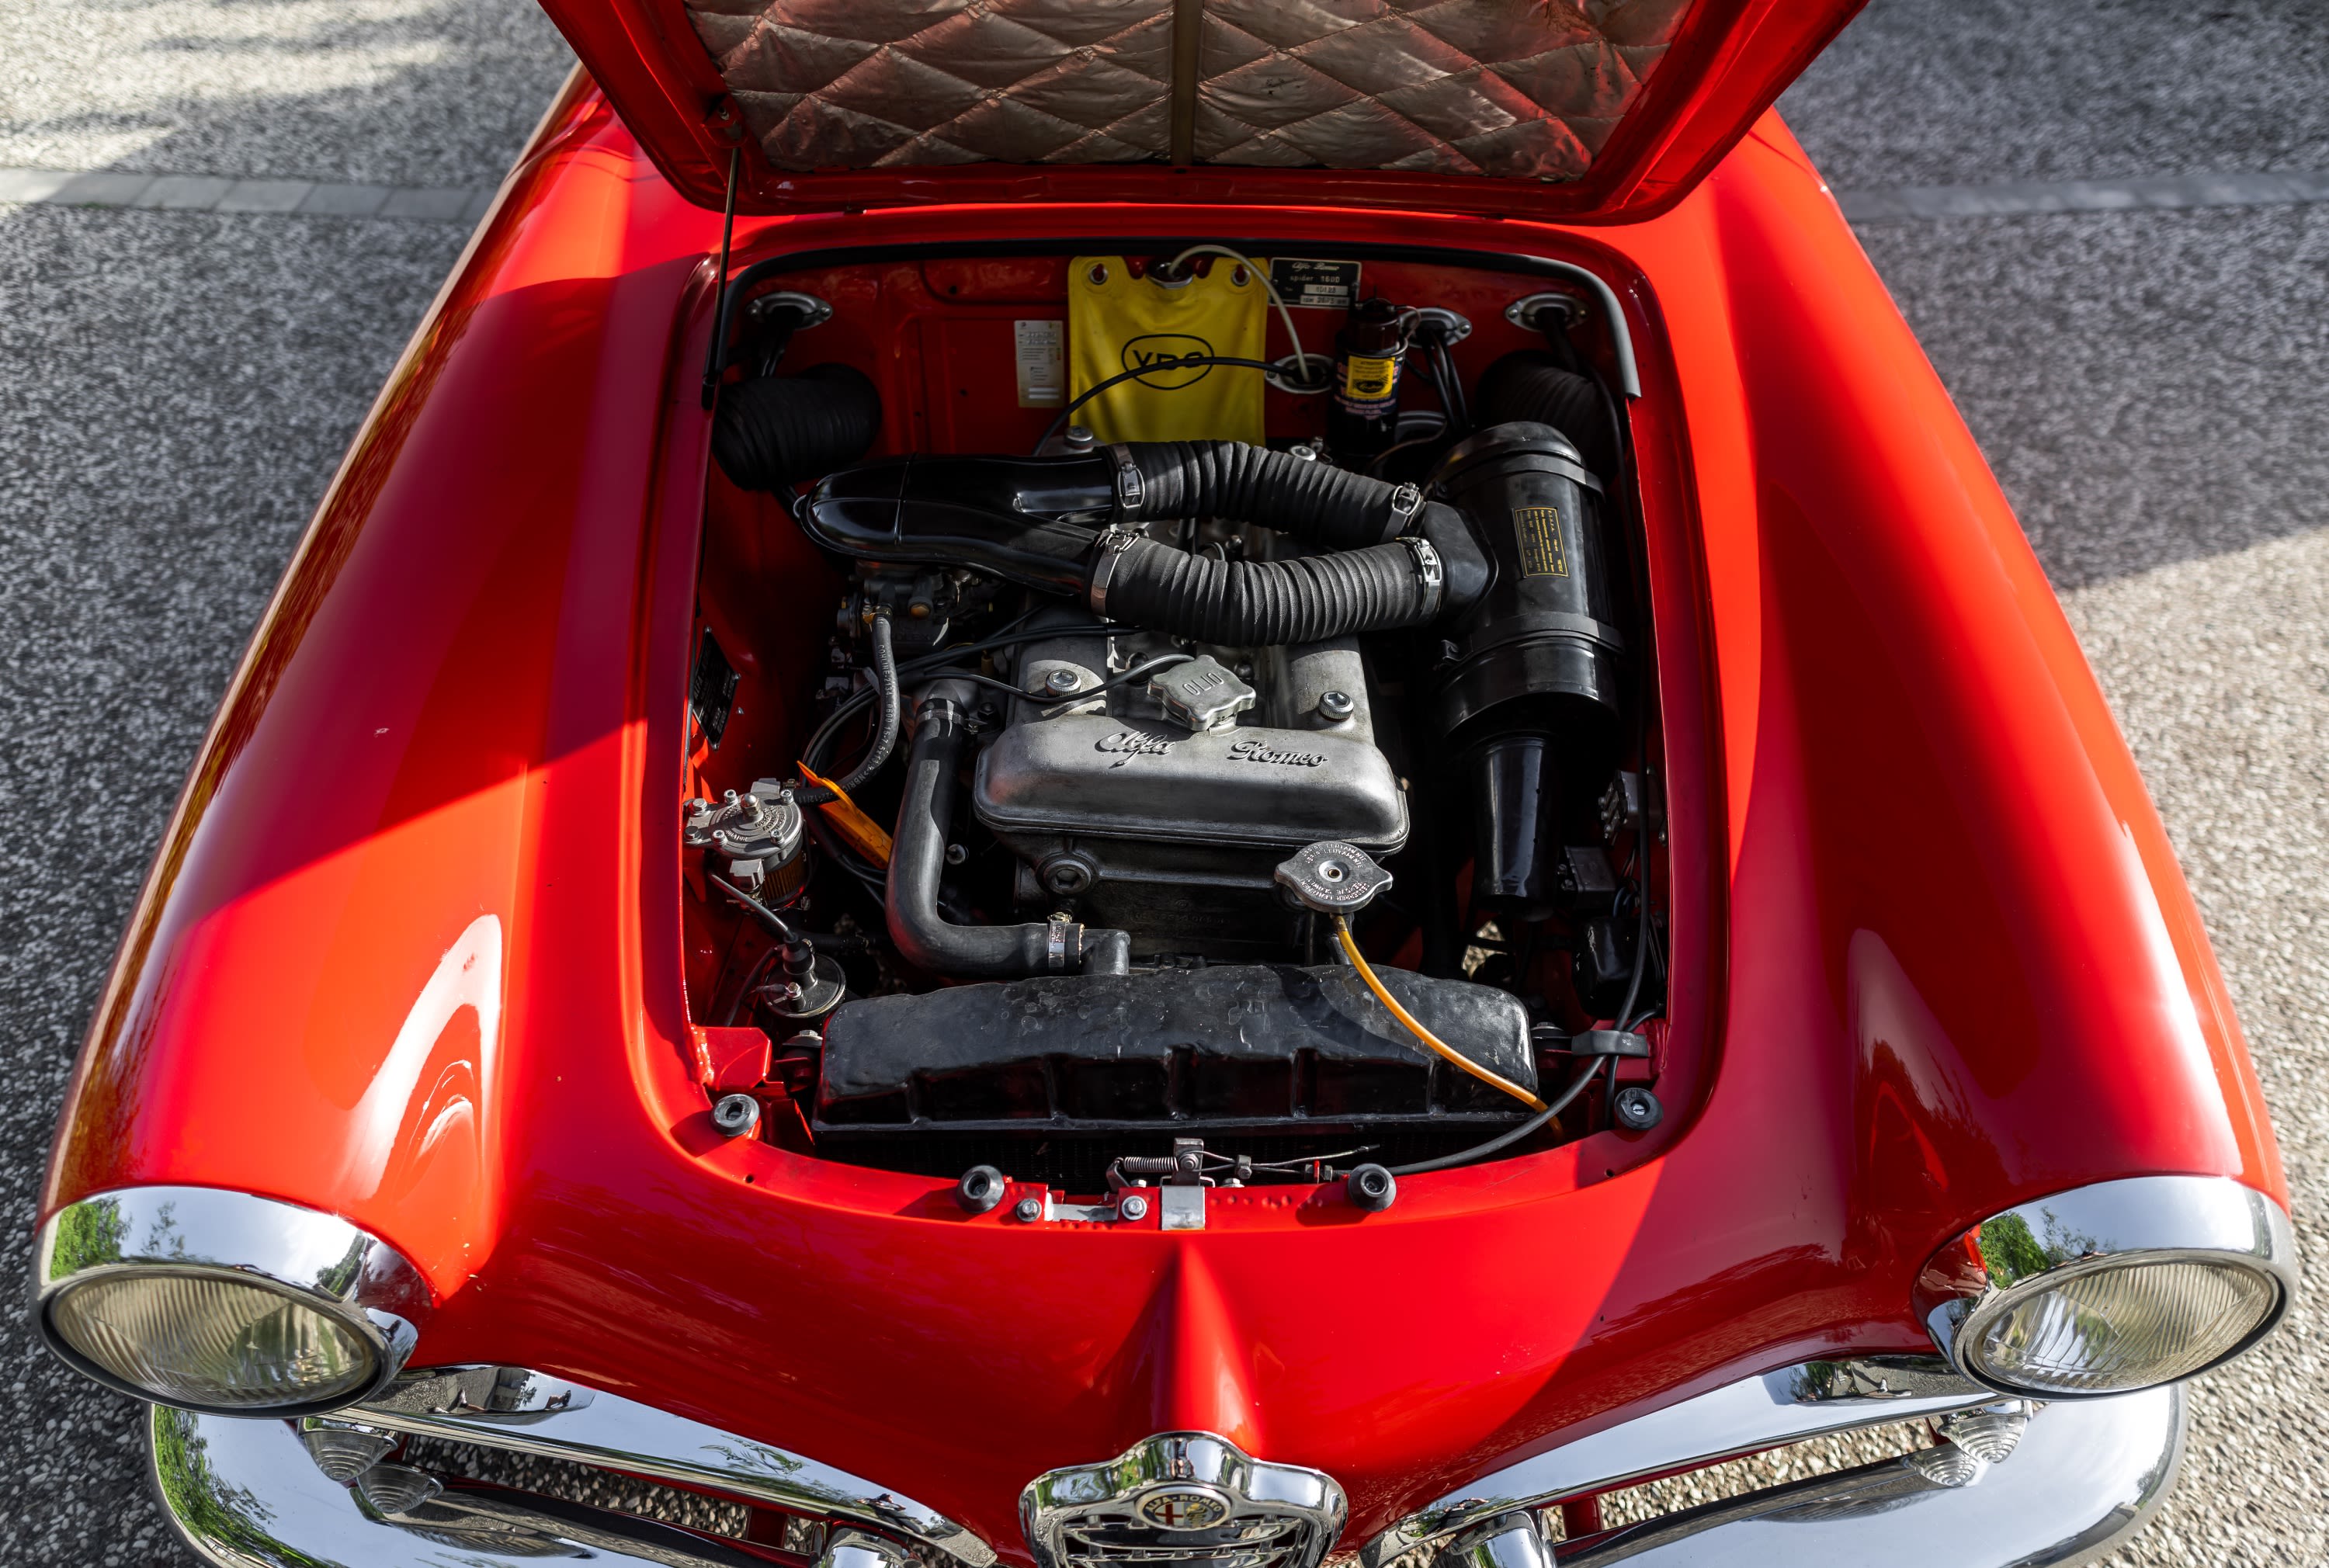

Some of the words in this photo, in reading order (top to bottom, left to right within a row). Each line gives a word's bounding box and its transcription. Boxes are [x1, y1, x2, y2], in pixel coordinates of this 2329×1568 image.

[1289, 274, 1314, 283] spider
[1132, 349, 1204, 370] VDO
[1182, 672, 1224, 696] OLIO
[1095, 731, 1176, 768] Alfa
[1227, 740, 1328, 767] Romeo
